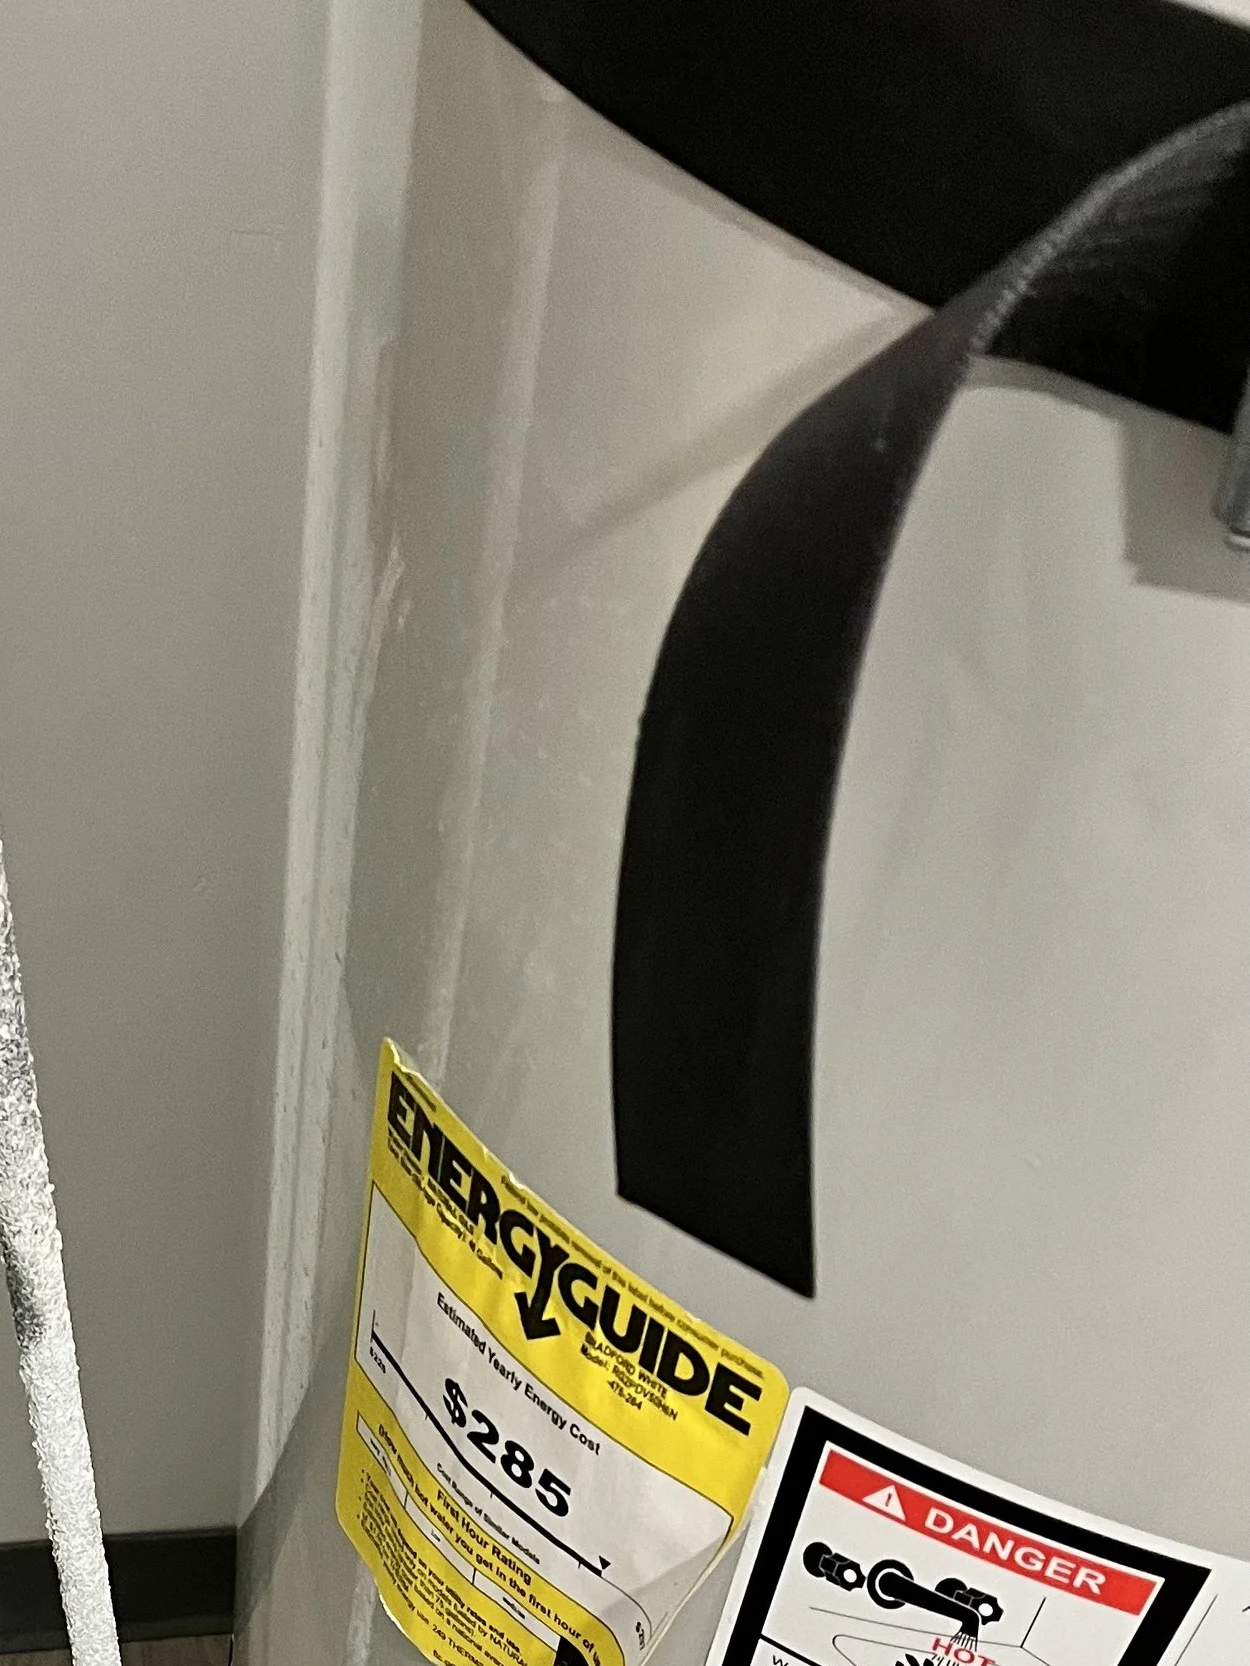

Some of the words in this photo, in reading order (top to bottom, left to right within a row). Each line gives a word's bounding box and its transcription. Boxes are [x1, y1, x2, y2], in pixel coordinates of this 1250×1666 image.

[388, 1071, 762, 1436] ENERGYGUIDE
[437, 1292, 486, 1354] Estimated
[488, 1347, 522, 1391] Yearly
[525, 1384, 567, 1431] Energy
[570, 1424, 601, 1455] Cost
[442, 1378, 572, 1517] $285
[414, 1487, 430, 1514] hot
[430, 1501, 455, 1536] water
[455, 1530, 474, 1555] you
[476, 1551, 495, 1573] get
[496, 1566, 508, 1585] in
[509, 1576, 527, 1597] the
[529, 1592, 551, 1619] first
[553, 1609, 582, 1642] hour
[582, 1637, 595, 1654] of
[436, 1489, 460, 1525] First
[462, 1517, 490, 1551] Hour
[492, 1541, 533, 1588] Rating
[924, 1506, 1106, 1595] DANGER
